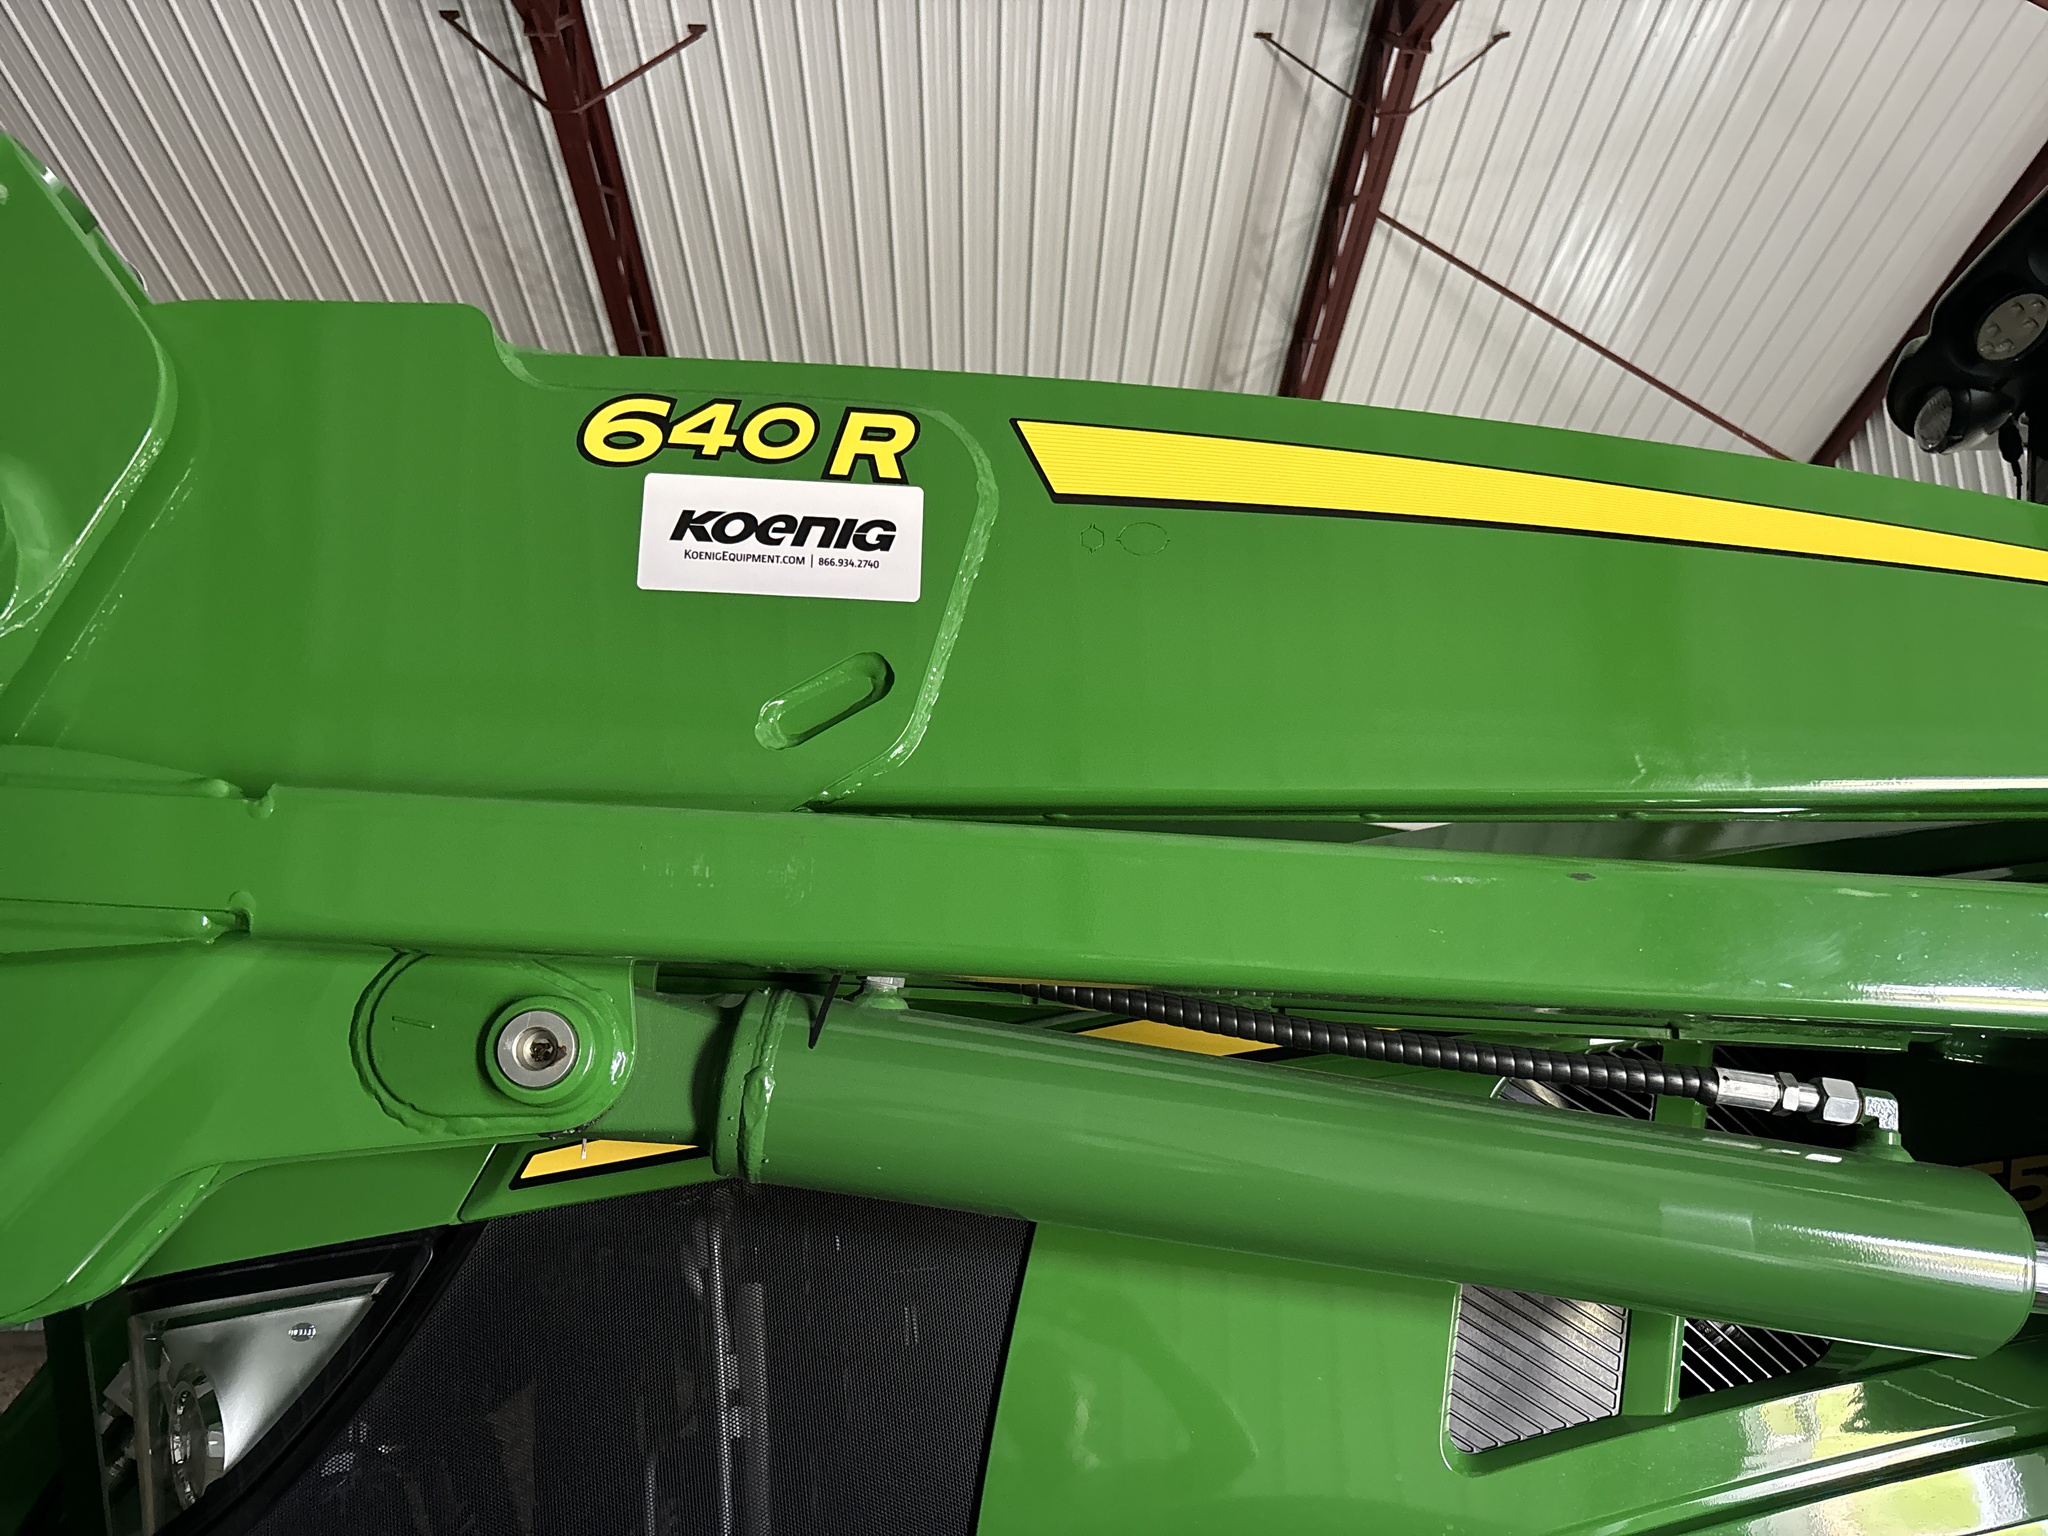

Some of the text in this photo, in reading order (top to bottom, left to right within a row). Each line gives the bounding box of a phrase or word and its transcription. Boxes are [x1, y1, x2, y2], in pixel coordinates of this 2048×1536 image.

[578, 395, 919, 483] 640 R
[817, 556, 880, 569] 866.934.2740
